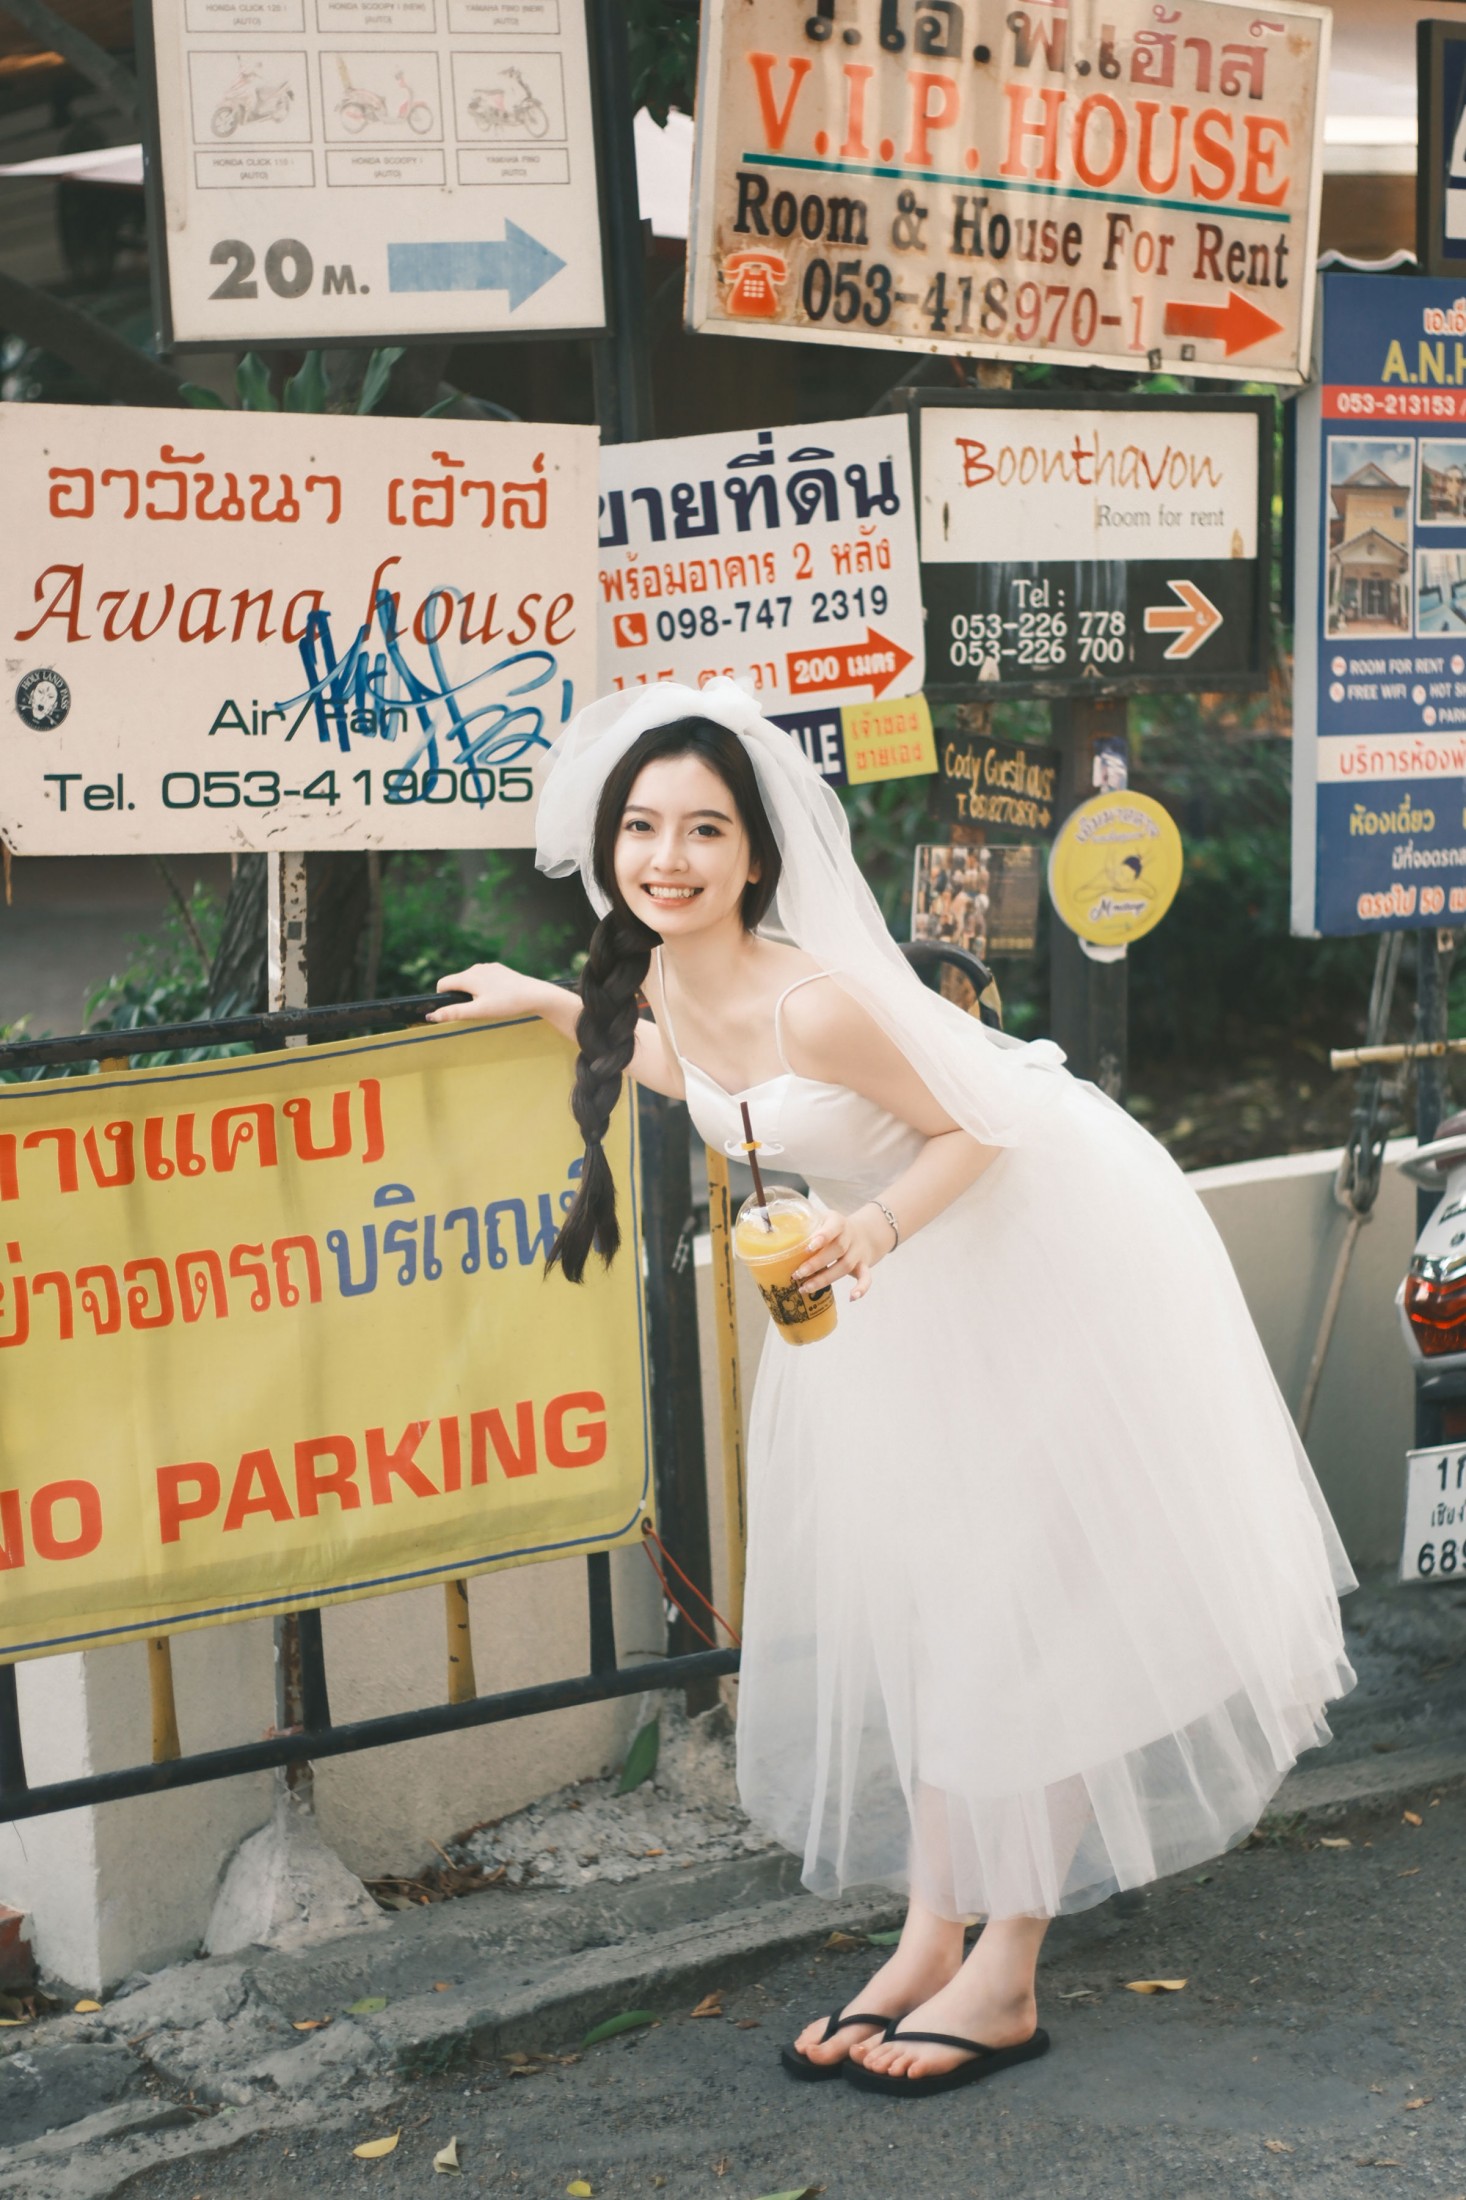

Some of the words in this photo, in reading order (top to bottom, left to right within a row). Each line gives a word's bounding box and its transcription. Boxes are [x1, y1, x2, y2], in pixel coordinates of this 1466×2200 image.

[1000, 84, 1292, 207] HOUSE
[733, 172, 869, 246] Room
[892, 189, 929, 251] &
[951, 193, 1083, 267] House
[1103, 212, 1175, 277] For
[1193, 222, 1290, 289] Rent
[208, 238, 313, 300] 20
[322, 265, 371, 296] M.
[802, 257, 1147, 352] 053-418970-1
[48, 444, 342, 524] อาวันนา
[599, 430, 901, 548] ขายที่ดิน
[1097, 505, 1151, 528] Room
[1158, 504, 1182, 527] for
[1190, 505, 1225, 527] rent
[599, 550, 776, 603] พร้อมอาคาร
[792, 541, 814, 581] 2
[830, 524, 892, 576] หลัง
[14, 562, 326, 644] Awana
[363, 556, 577, 646] house
[656, 596, 794, 642] 098-747
[810, 584, 889, 623] 2319
[951, 613, 1068, 640] 053-226
[1078, 611, 1126, 638] 778
[793, 655, 840, 685] 200
[950, 639, 1067, 666] 053-226
[1078, 637, 1124, 663] 700
[1349, 658, 1387, 676] ROOM
[1388, 657, 1413, 675] FOR
[1414, 656, 1445, 675] RENT
[1347, 683, 1379, 701] FREE
[44, 773, 136, 813] Tel.
[162, 766, 534, 812] 053-419005
[1419, 885, 1446, 916] 50
[155, 1390, 608, 1546] PARKING
[1417, 1539, 1466, 1577] 68
